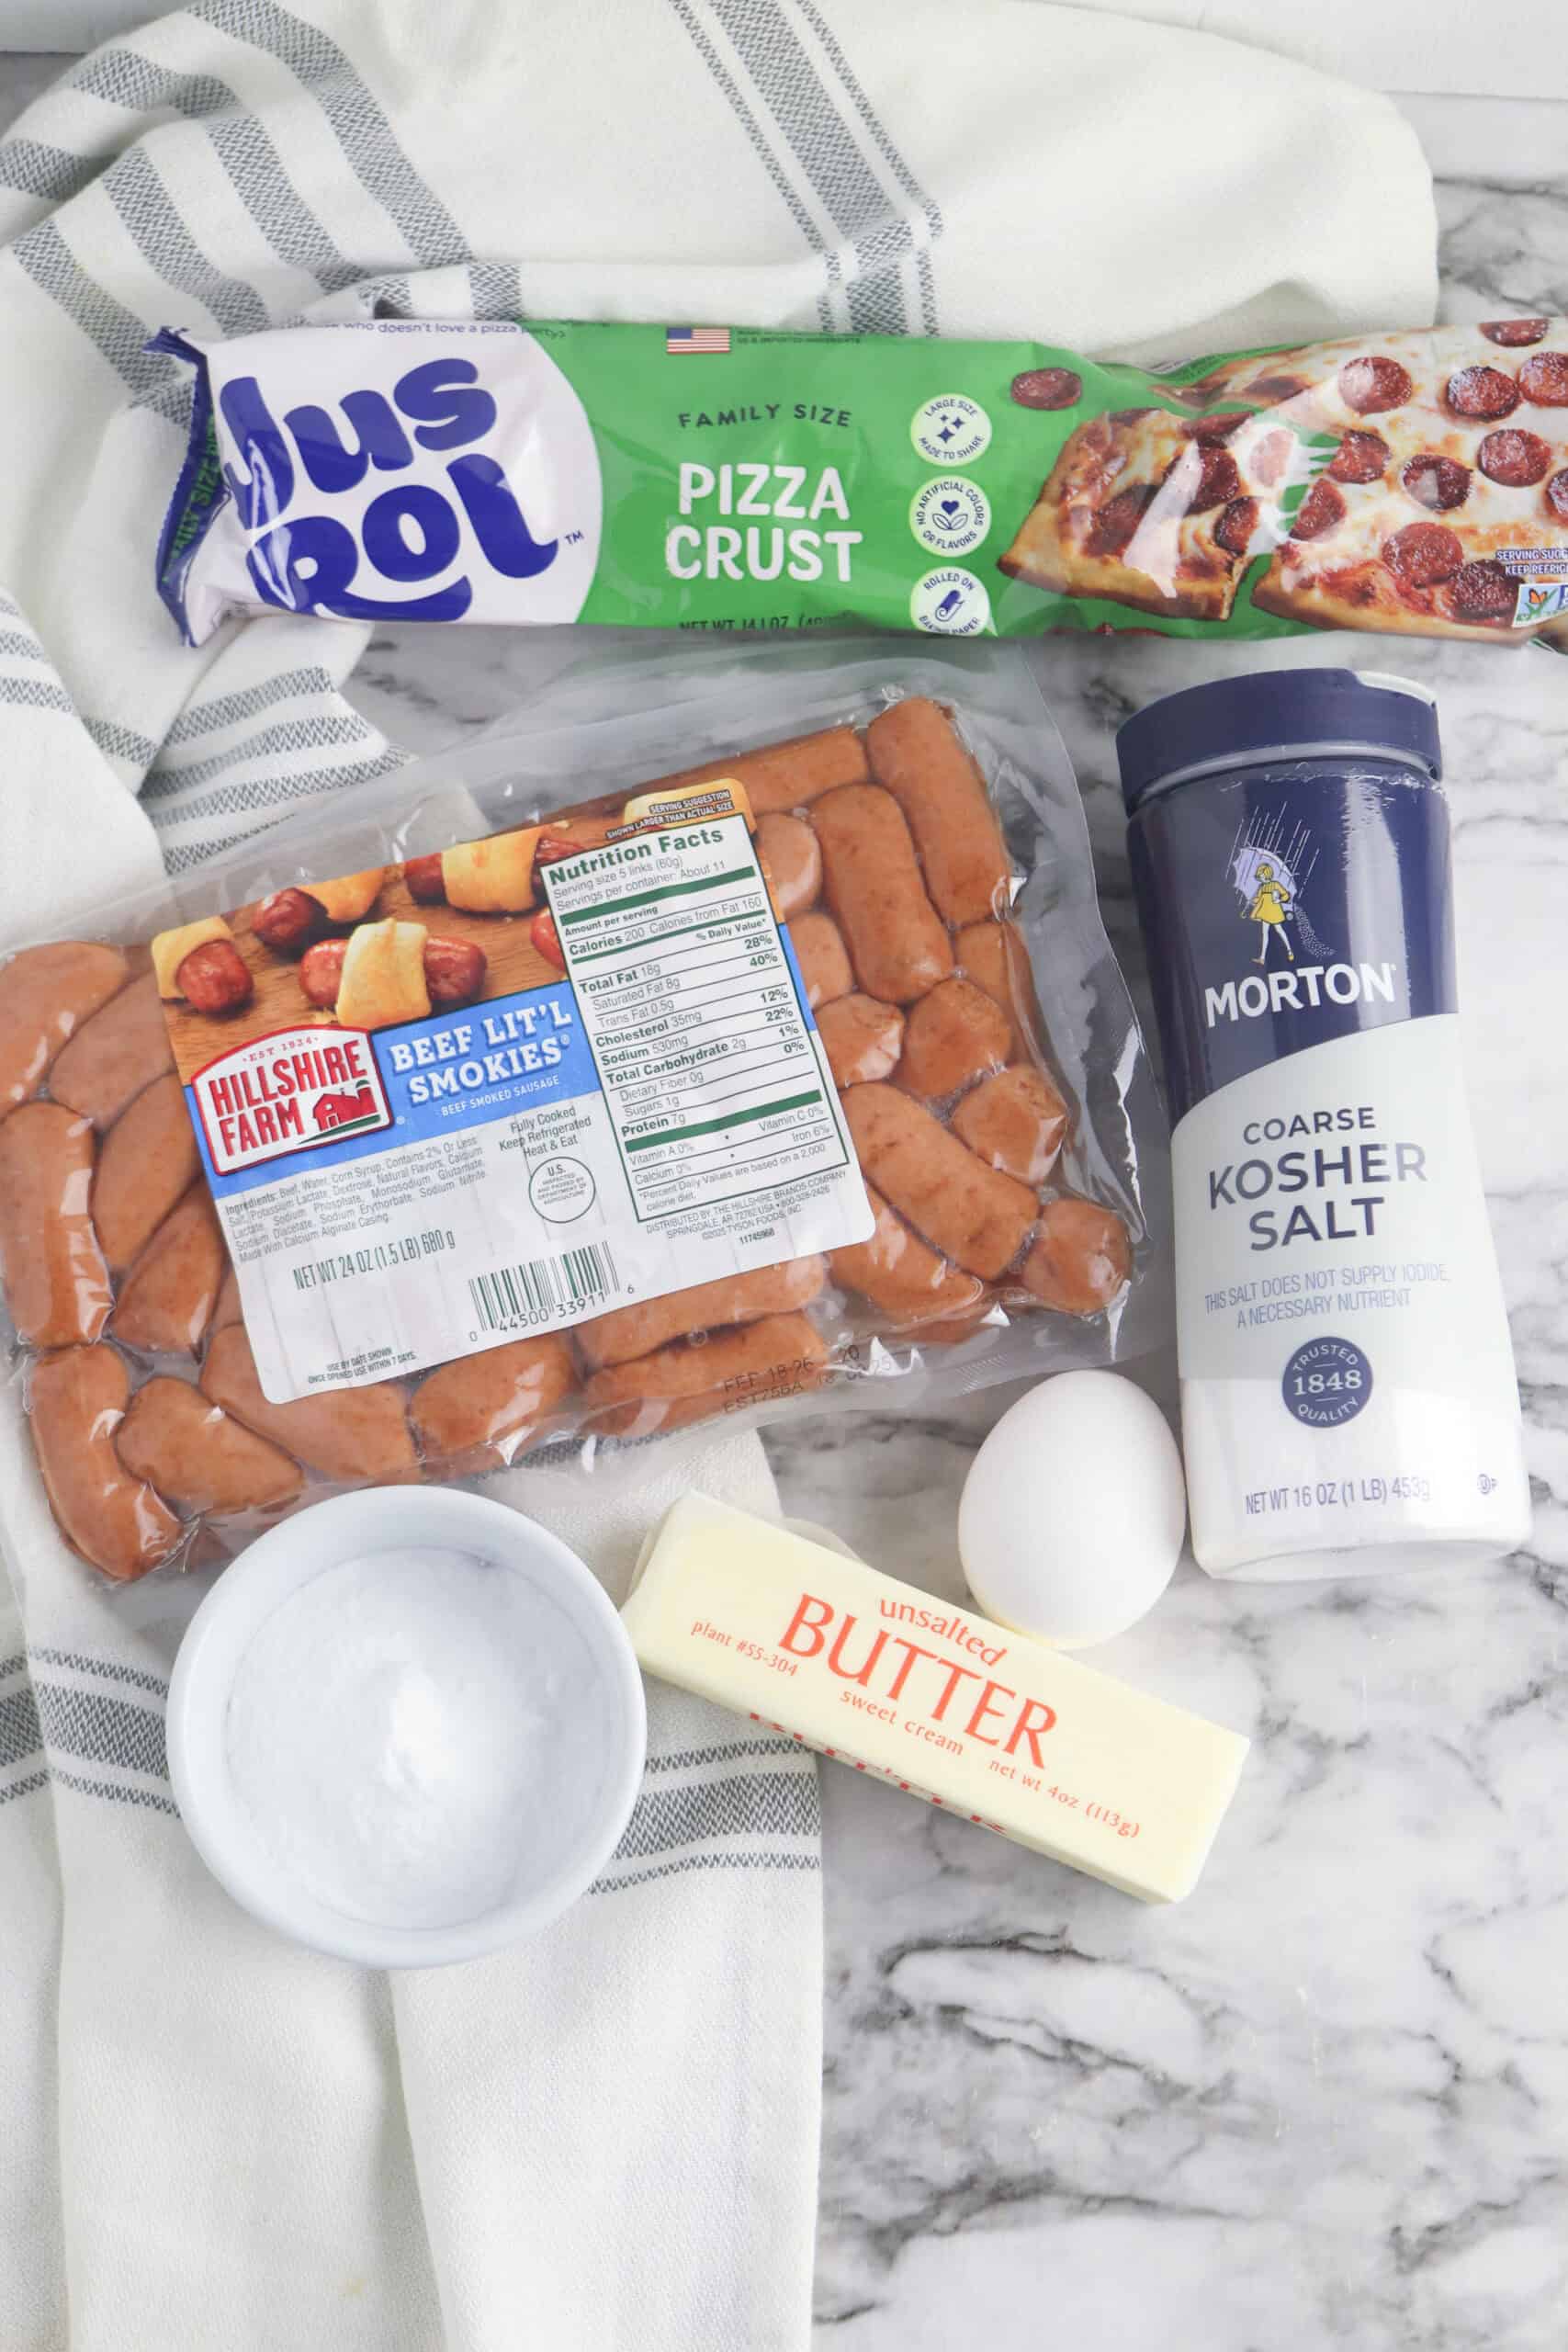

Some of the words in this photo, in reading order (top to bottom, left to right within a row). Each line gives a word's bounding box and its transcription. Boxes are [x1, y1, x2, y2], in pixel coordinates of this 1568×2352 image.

[378, 322, 432, 334] doesn't
[435, 323, 465, 333] love
[481, 323, 517, 334] pizza
[678, 403, 780, 428] FAMILY
[794, 403, 852, 427] SIZE
[924, 399, 956, 417] LARGE
[957, 400, 978, 417] SIZE
[919, 436, 941, 458] MADE
[943, 451, 955, 460] TO
[957, 435, 985, 458] SHARE
[679, 463, 851, 520] PIZZA
[919, 481, 964, 509] ARTIFICIAL
[965, 488, 985, 526] COLORS
[916, 511, 926, 525] NO
[666, 525, 863, 582] CRUST
[922, 530, 936, 544] OR
[936, 530, 977, 549] FLAVORS
[1496, 548, 1540, 560] SERVING
[923, 572, 960, 591] ROLLED
[961, 577, 975, 591] ON
[1505, 564, 1529, 575] KEEP
[650, 798, 682, 815] SERVING
[681, 788, 729, 807] SUGGESTION
[664, 812, 685, 821] THAN
[687, 806, 715, 818] ACTUAL
[547, 843, 651, 886] Nutrition
[658, 829, 723, 853] Facts
[553, 879, 593, 899] Serving
[595, 872, 617, 885] size
[618, 867, 626, 878] 5
[627, 863, 653, 875] links
[556, 890, 603, 910] Servings
[604, 885, 622, 899] per
[680, 864, 710, 878] About
[713, 859, 725, 871] 11
[565, 920, 602, 936] Amount
[604, 916, 619, 927] per
[622, 906, 658, 922] serving
[569, 935, 623, 956] Calories
[624, 926, 645, 942] 200
[649, 915, 693, 933] Calories
[694, 908, 719, 921] from
[721, 902, 739, 914] Fat
[741, 896, 761, 909] 160
[707, 926, 732, 938] Daily
[578, 976, 614, 993] Total
[616, 969, 638, 984] Fat
[640, 964, 660, 976] 18g
[744, 934, 772, 949] 28%
[592, 986, 645, 1010] Saturated
[646, 980, 663, 994] Fat
[665, 978, 680, 989] 8g
[750, 953, 778, 967] 40%
[597, 1013, 629, 1027] Trans
[630, 1006, 649, 1020] Fat
[649, 1000, 674, 1014] 0.5g
[1204, 962, 1396, 1028] MORTON
[389, 1024, 472, 1071] BEEF
[482, 1001, 572, 1044] LIT'L
[595, 1018, 669, 1047] Cholesterol
[670, 1011, 702, 1027] 35mg
[761, 988, 788, 1002] 12%
[600, 1047, 649, 1066] Sodium
[651, 1035, 689, 1054] 530mg
[764, 1007, 793, 1022] 22%
[605, 1067, 640, 1084] Total
[643, 1043, 730, 1075] Carbohydrate
[731, 1038, 747, 1050] 2g
[778, 1023, 799, 1036] 1%
[618, 1083, 657, 1102] Dietary
[660, 1076, 687, 1090] Fiber
[689, 1071, 704, 1083] 0g
[783, 1040, 805, 1053] 0%
[208, 1039, 369, 1117] HILLSHIRE
[441, 1100, 467, 1115] BEEF
[469, 1089, 512, 1108] SMOKED
[513, 1074, 559, 1095] SAUSAGE
[510, 1118, 535, 1133] Fully
[536, 1104, 576, 1125] Cooked
[620, 1116, 669, 1136] Protein
[670, 1113, 685, 1125] 7g
[624, 1100, 663, 1117] Sugars
[665, 1096, 680, 1107] 1g
[216, 1097, 305, 1157] FARM
[499, 1136, 525, 1151] Keep
[526, 1115, 592, 1142] Refrigerated
[1243, 1107, 1376, 1145] COARSE
[523, 1142, 547, 1159] Heat
[549, 1140, 558, 1150] &
[559, 1134, 578, 1147] Eat
[547, 1163, 566, 1176] U.S.
[1209, 1142, 1427, 1210] KOSHER
[1249, 1196, 1384, 1251] SALT
[293, 1263, 316, 1289] NET
[316, 1258, 337, 1283] WT
[337, 1254, 355, 1278] 24
[355, 1249, 374, 1272] OZ
[374, 1242, 399, 1270] (1.5
[399, 1237, 421, 1261] LB)
[420, 1229, 445, 1254] 680
[446, 1230, 455, 1249] g
[1205, 1290, 1227, 1315] THIS
[1228, 1283, 1258, 1305] SALT
[1261, 1274, 1302, 1297] DOES
[1304, 1270, 1335, 1291] NOT
[1342, 1263, 1397, 1286] SUPPLY
[468, 1330, 478, 1341] 0
[499, 1307, 548, 1331] 44500
[555, 1291, 604, 1317] 33911
[626, 1284, 634, 1294] 6
[1237, 1310, 1247, 1329] A
[1249, 1295, 1333, 1327] NECESSARY
[1337, 1288, 1412, 1312] NUTRIENT
[1292, 1344, 1359, 1373] TRUSTED
[1292, 1369, 1362, 1396] 1848
[1298, 1396, 1359, 1422] QUALITY
[1246, 1490, 1268, 1515] NET
[1269, 1487, 1290, 1510] WT
[1293, 1486, 1312, 1508] 16
[1316, 1482, 1338, 1506] OZ
[1342, 1480, 1355, 1508] (1
[1361, 1477, 1388, 1504] LB)
[690, 1619, 733, 1649] plant
[736, 1637, 800, 1678] #55-304
[878, 1598, 1008, 1668] unsalted
[779, 1592, 1057, 1770] BUTTER
[839, 1689, 899, 1728] sweet
[904, 1718, 964, 1758] cream
[989, 1758, 1017, 1781] net
[1021, 1773, 1042, 1792] wt
[1047, 1783, 1080, 1810] 4oz
[1084, 1799, 1143, 1839] (113g)
